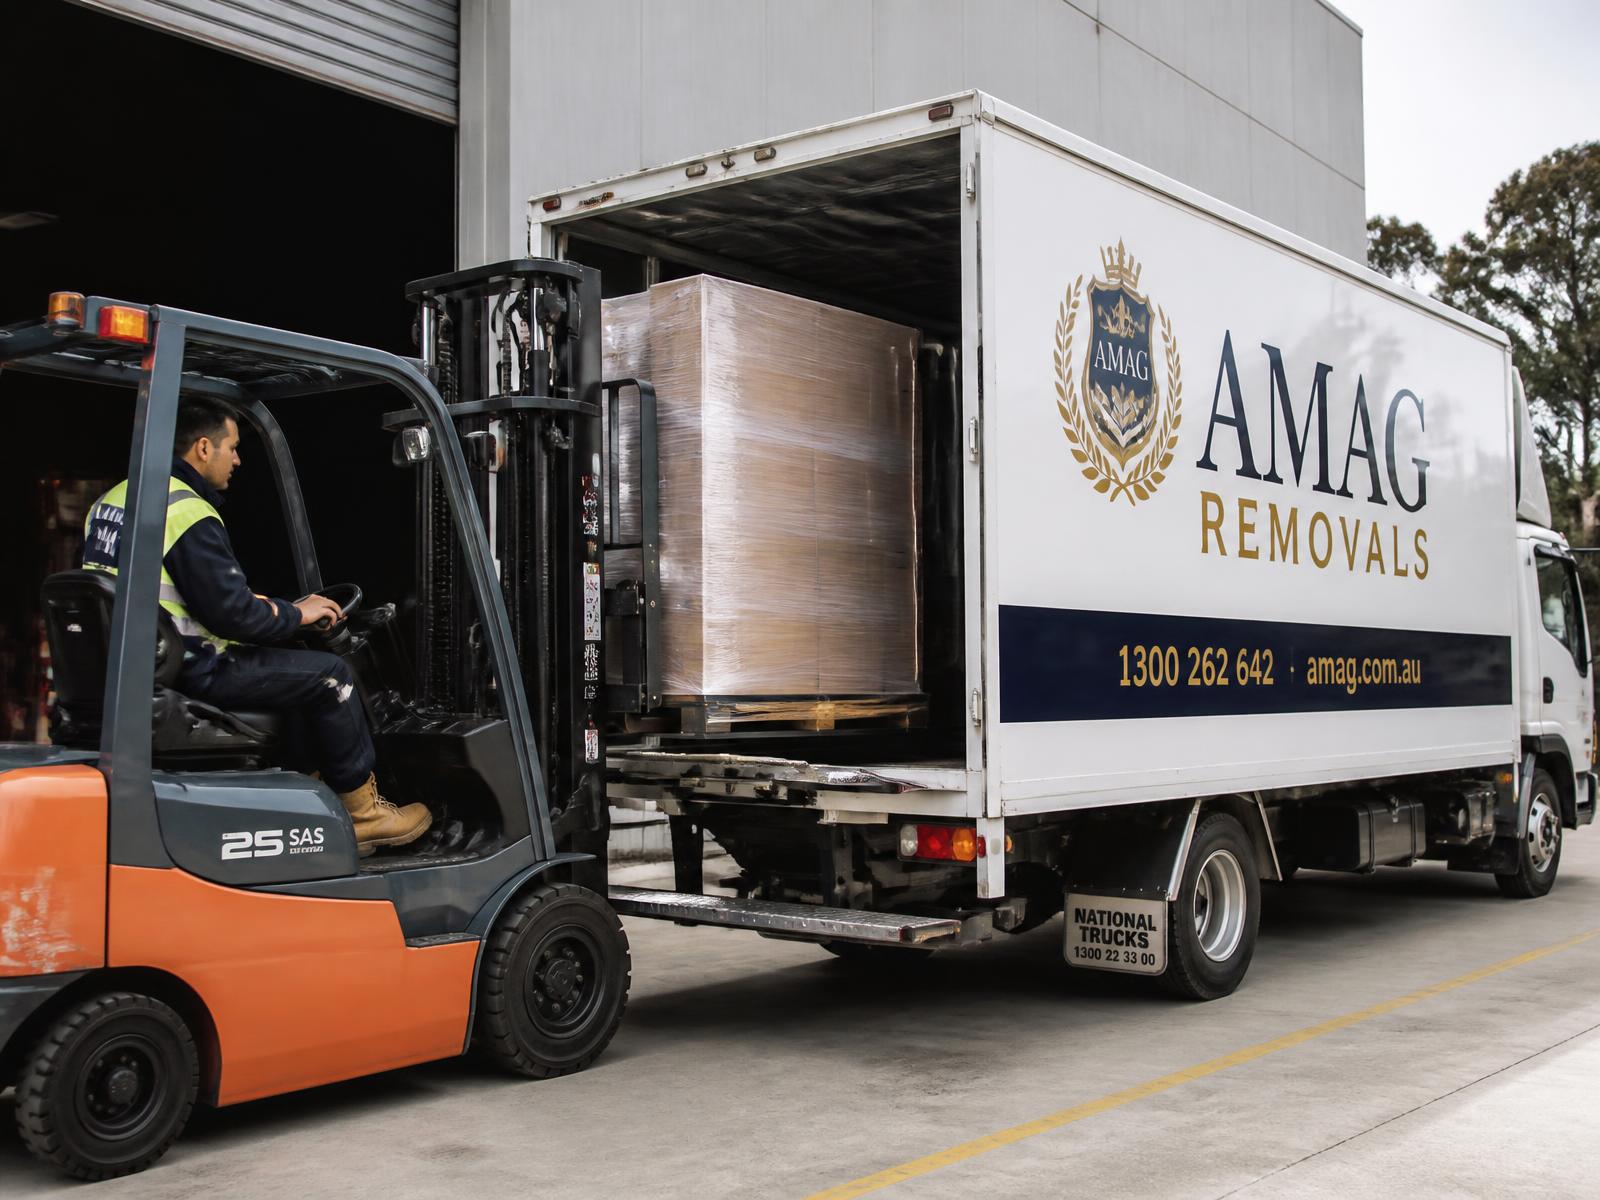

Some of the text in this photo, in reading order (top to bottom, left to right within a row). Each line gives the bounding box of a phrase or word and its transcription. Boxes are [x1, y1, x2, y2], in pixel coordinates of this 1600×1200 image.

[1093, 339, 1149, 381] AMAG
[1196, 329, 1430, 514] AMAG
[1199, 490, 1430, 581] REMOVALS
[1118, 645, 1422, 695] 1300 262 642 amag.com.au
[221, 827, 324, 860] 25 SAS
[1074, 907, 1157, 931] NATIONAL
[1079, 925, 1149, 949] TRUCKS
[1074, 946, 1155, 965] 1300 22 33 00
